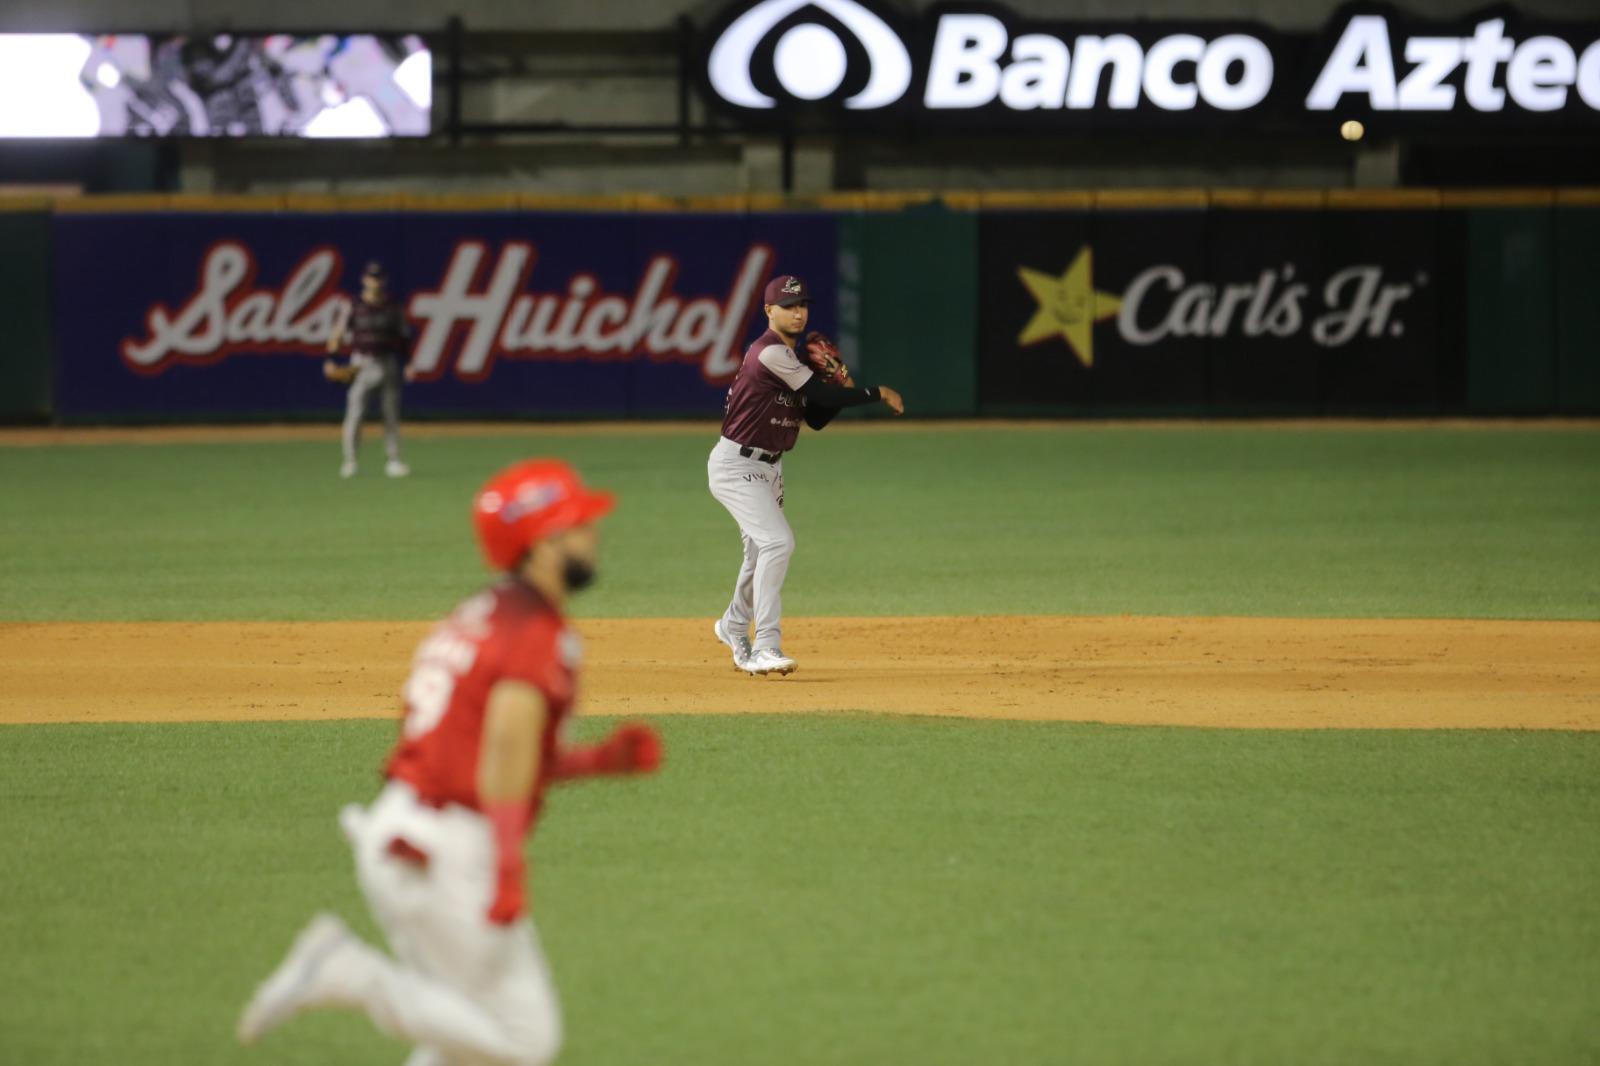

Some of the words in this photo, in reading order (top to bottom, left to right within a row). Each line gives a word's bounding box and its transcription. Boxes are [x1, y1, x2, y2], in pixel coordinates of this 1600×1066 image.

[923, 12, 1275, 111] Banco
[404, 240, 771, 378] Huichol
[1116, 262, 1309, 346] Carl's
[1311, 265, 1411, 347] Jr.
